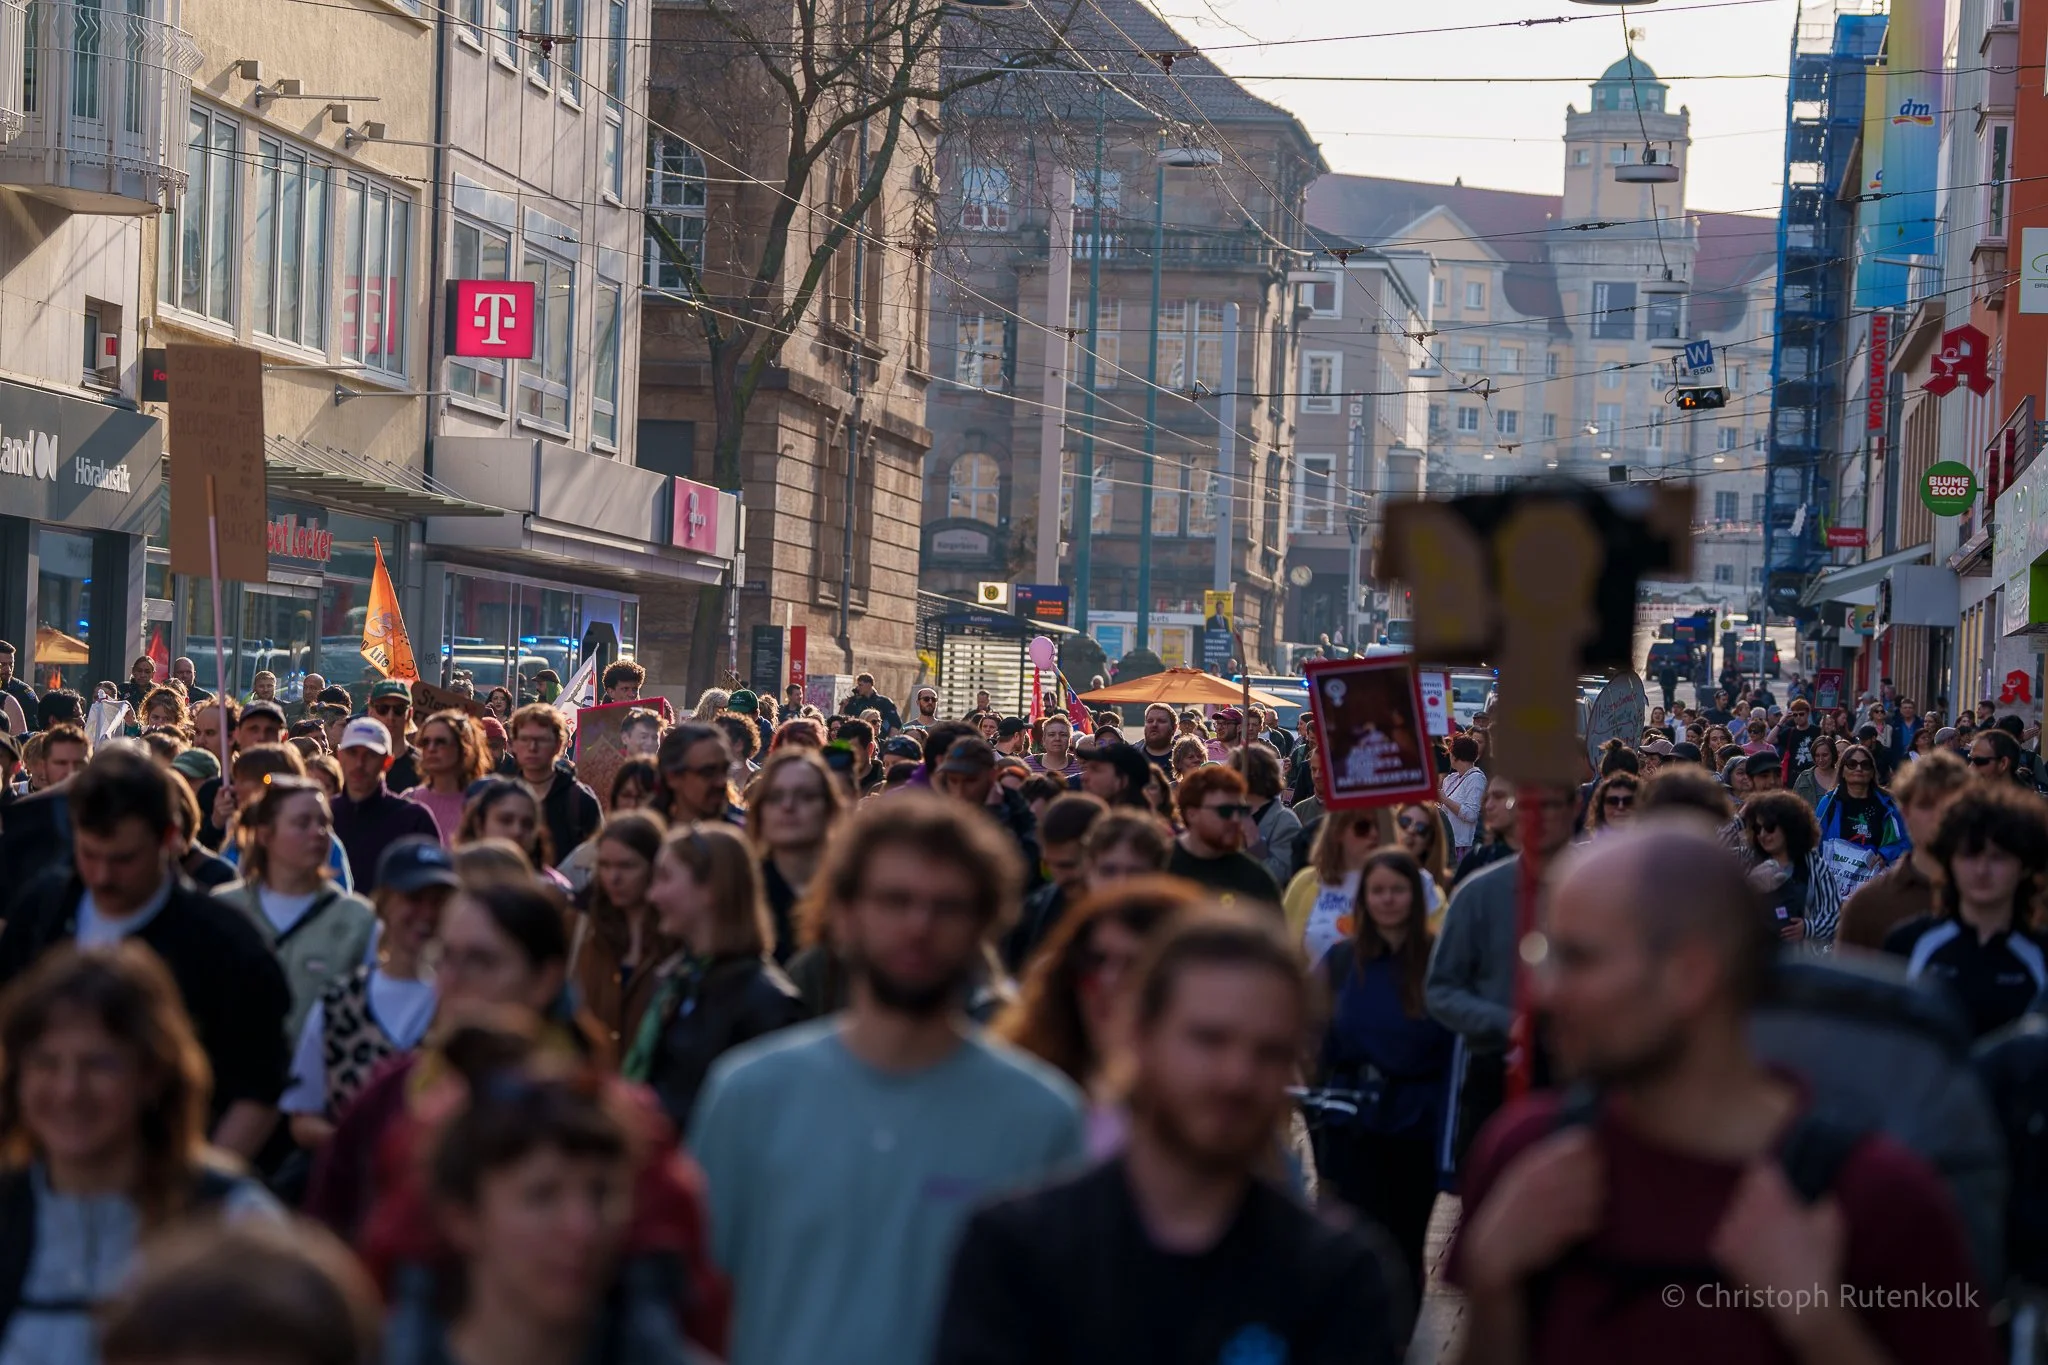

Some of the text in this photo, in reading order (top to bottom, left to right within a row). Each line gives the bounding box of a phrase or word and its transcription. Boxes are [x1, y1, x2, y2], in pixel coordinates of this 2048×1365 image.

[1900, 99, 1930, 116] dm
[474, 293, 516, 345] T
[1687, 343, 1708, 365] W
[1693, 366, 1712, 376] 850
[1868, 315, 1888, 430] WOOLWORTH
[0, 424, 34, 477] and
[74, 456, 131, 493] Hörakustik
[1928, 476, 1969, 487] BLUME
[1931, 486, 1967, 497] 2000
[267, 514, 334, 562] oot Locker
[369, 647, 390, 668] Life
